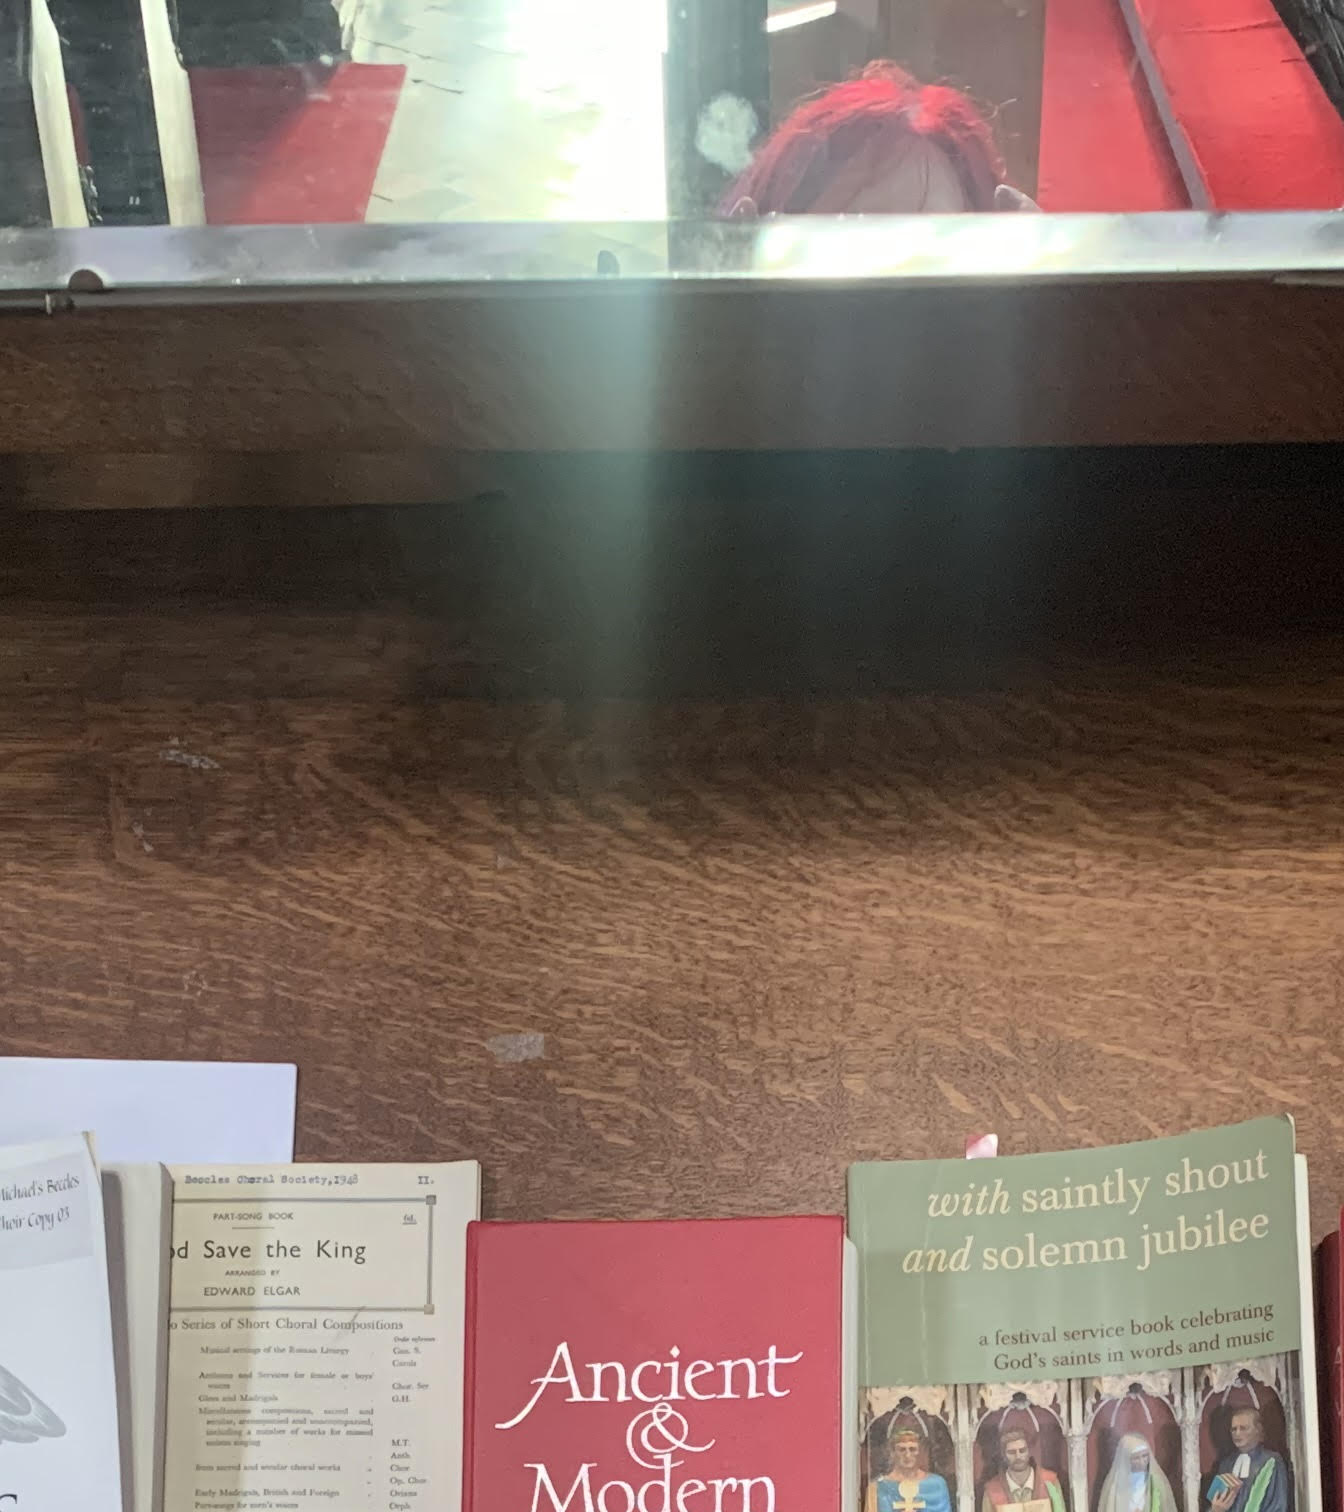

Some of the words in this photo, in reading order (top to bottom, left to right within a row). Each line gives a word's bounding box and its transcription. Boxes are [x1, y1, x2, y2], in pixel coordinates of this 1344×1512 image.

[926, 1178, 1010, 1218] with
[1021, 1167, 1151, 1216] saintly
[1164, 1148, 1270, 1198] shout
[28, 1212, 55, 1232] Copy
[268, 1211, 295, 1221] BOOK
[203, 1239, 252, 1260] Save
[265, 1239, 302, 1260] the
[316, 1239, 367, 1265] King
[902, 1236, 975, 1274] and
[982, 1232, 1129, 1272] solemn
[1136, 1208, 1270, 1272] jubilee
[203, 1286, 257, 1297] EDWARD
[262, 1286, 302, 1297] ELGAR
[181, 1318, 217, 1330] Series
[220, 1317, 235, 1330] of
[237, 1317, 271, 1330] Short
[275, 1317, 318, 1330] Choral
[322, 1318, 405, 1334] Compositions
[978, 1331, 989, 1348] a
[994, 1325, 1058, 1346] festival
[1062, 1321, 1126, 1342] service
[1130, 1314, 1175, 1337] book
[1179, 1300, 1275, 1331] celebrating
[993, 1351, 1048, 1372] God's
[1051, 1349, 1102, 1368] saints
[1106, 1346, 1125, 1363] in
[1129, 1339, 1184, 1361] words
[1188, 1334, 1221, 1355] and
[1225, 1327, 1276, 1350] music
[495, 1341, 804, 1429] Ancient
[626, 1402, 716, 1469] &
